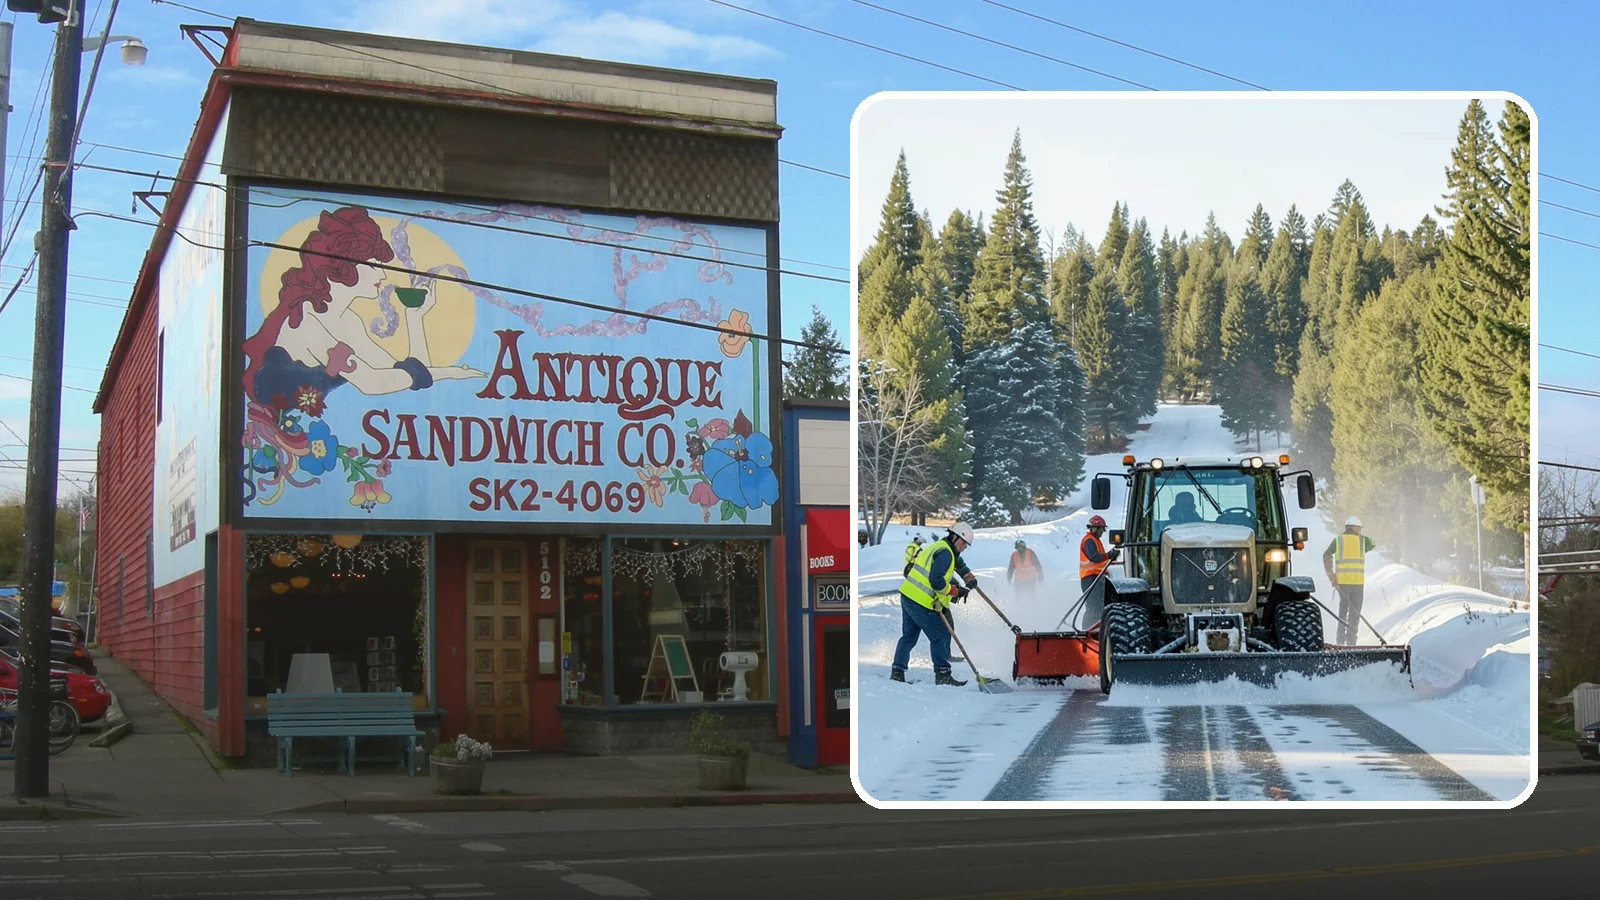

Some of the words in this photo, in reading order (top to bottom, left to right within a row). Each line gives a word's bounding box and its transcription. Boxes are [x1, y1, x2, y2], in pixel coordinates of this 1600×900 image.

[475, 328, 724, 421] ANTIQUE
[361, 408, 604, 468] SANDWICH
[617, 422, 685, 469] CO.
[468, 476, 646, 513] SK2-4069
[539, 541, 552, 600] 5102
[809, 555, 835, 569] BOOKS
